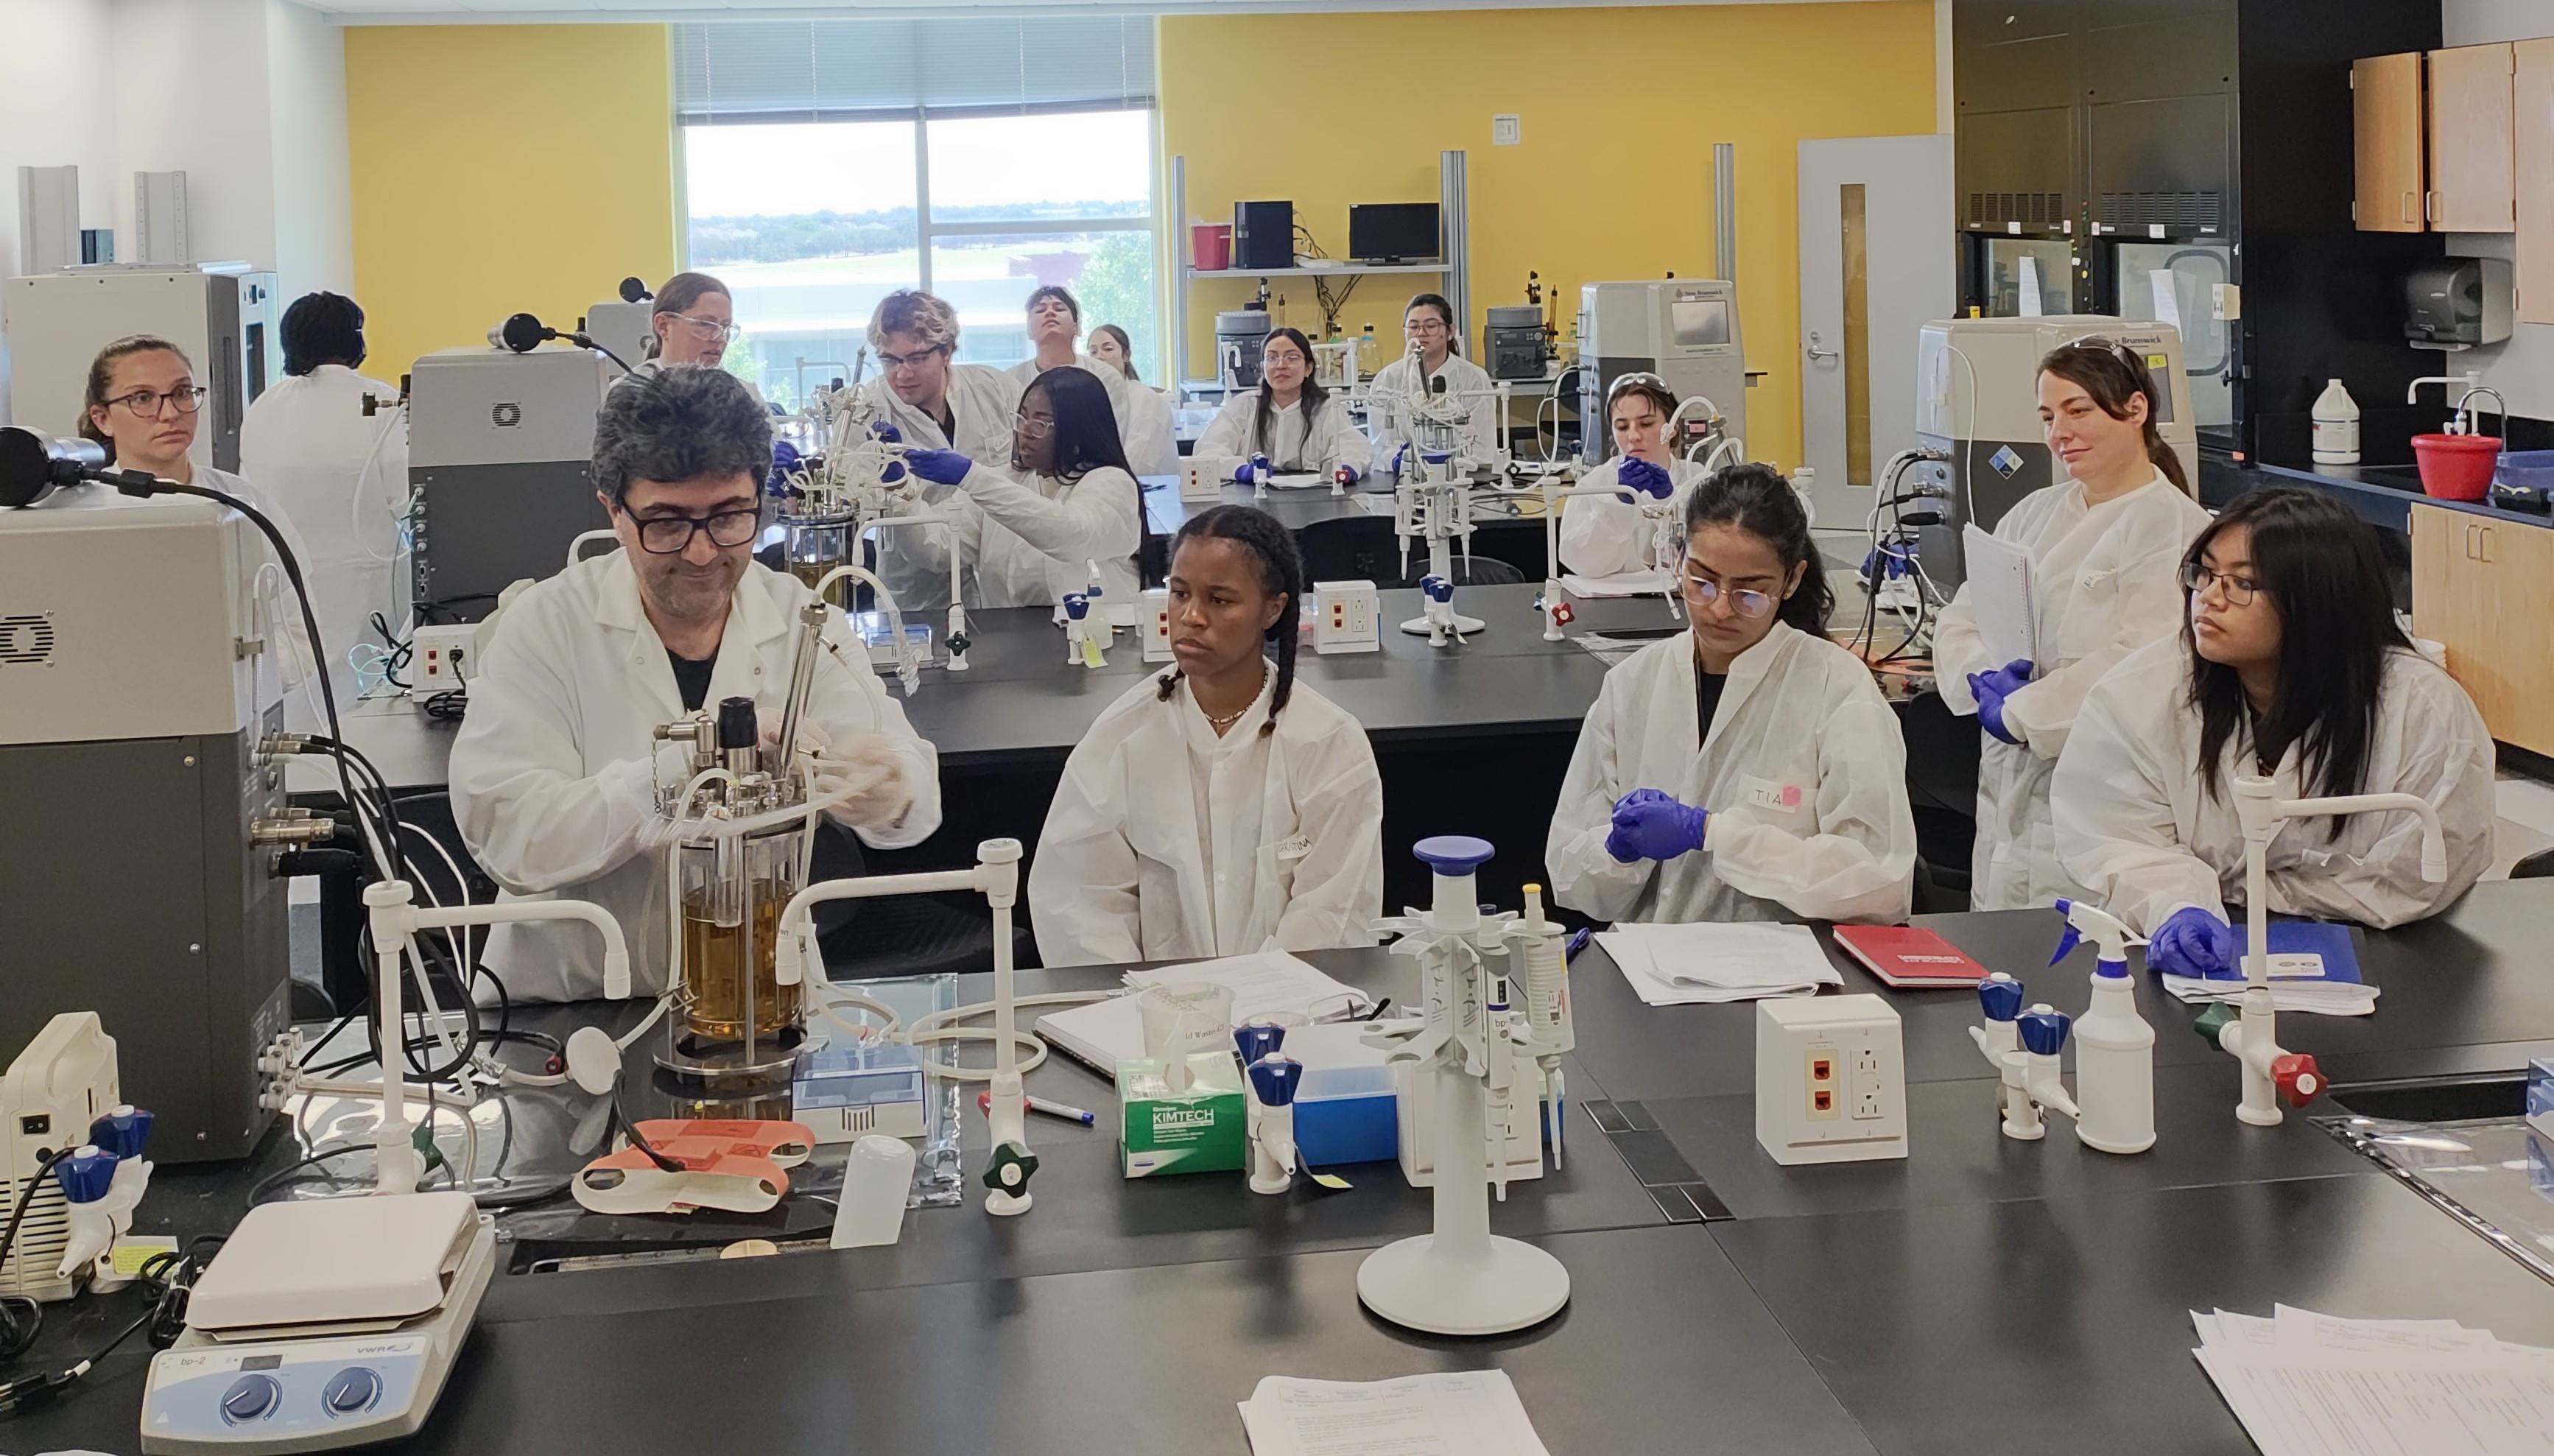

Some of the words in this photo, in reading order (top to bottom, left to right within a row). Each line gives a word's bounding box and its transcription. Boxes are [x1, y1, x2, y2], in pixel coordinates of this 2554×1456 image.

[2122, 335, 2161, 345] Brunswick
[1755, 789, 1781, 806] TIA
[1153, 1108, 1214, 1124] KIMTECH
[180, 1357, 206, 1366] bp-2
